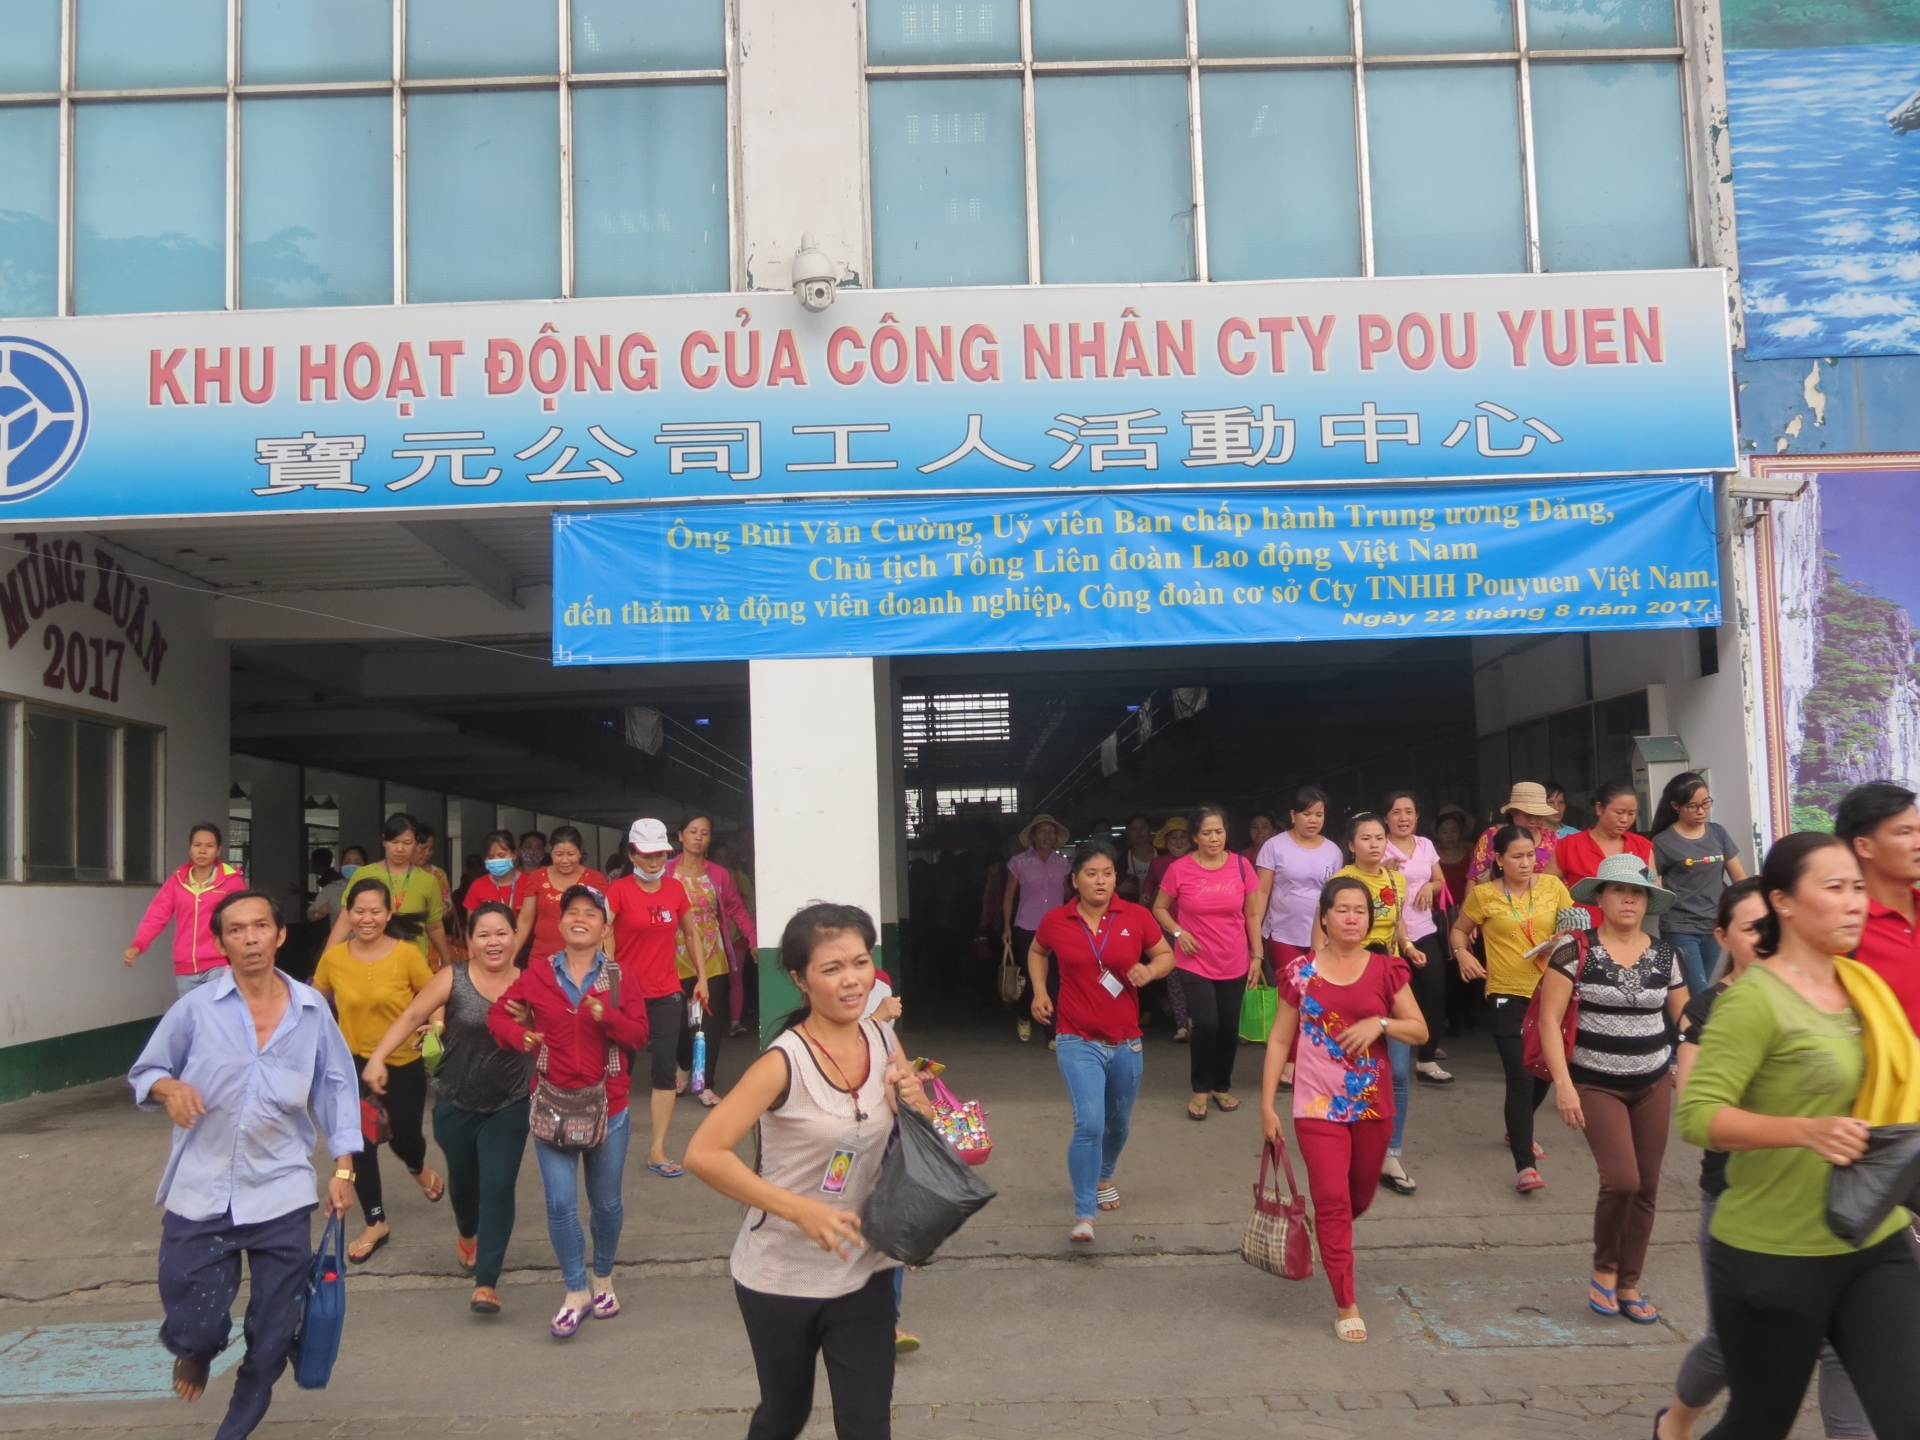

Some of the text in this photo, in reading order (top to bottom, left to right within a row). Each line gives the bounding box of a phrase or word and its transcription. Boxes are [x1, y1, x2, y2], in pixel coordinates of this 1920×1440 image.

[149, 306, 1664, 417] KHU HOẠT ĐỘNG CỦA CÔNG NHÂN CTY POU YUEN
[251, 400, 1564, 497] 寶元公司工人活動中心
[667, 518, 731, 554] Ông
[741, 521, 792, 547] Bùi
[801, 520, 861, 545] Văn
[872, 517, 982, 546] Cường,
[1042, 510, 1103, 536] viên
[1114, 509, 1172, 534] Ban
[1182, 501, 1252, 537] chấp
[1262, 505, 1335, 530] hành
[1344, 504, 1436, 532] Trung
[1445, 504, 1520, 529] ương
[1528, 497, 1615, 525] Đảng,
[809, 538, 1478, 585] Chủ tịch Tổng Liên đoàn Lao động Việt Nam
[564, 565, 1718, 626] đến thăm và động viên doanh nghiệp, Công đoàn cơ sở Cty TNHH Pouyuen Việt Nam.
[1342, 598, 1711, 628] Ngày 22 tháng 8 năm 2017
[43, 624, 125, 702] 2017
